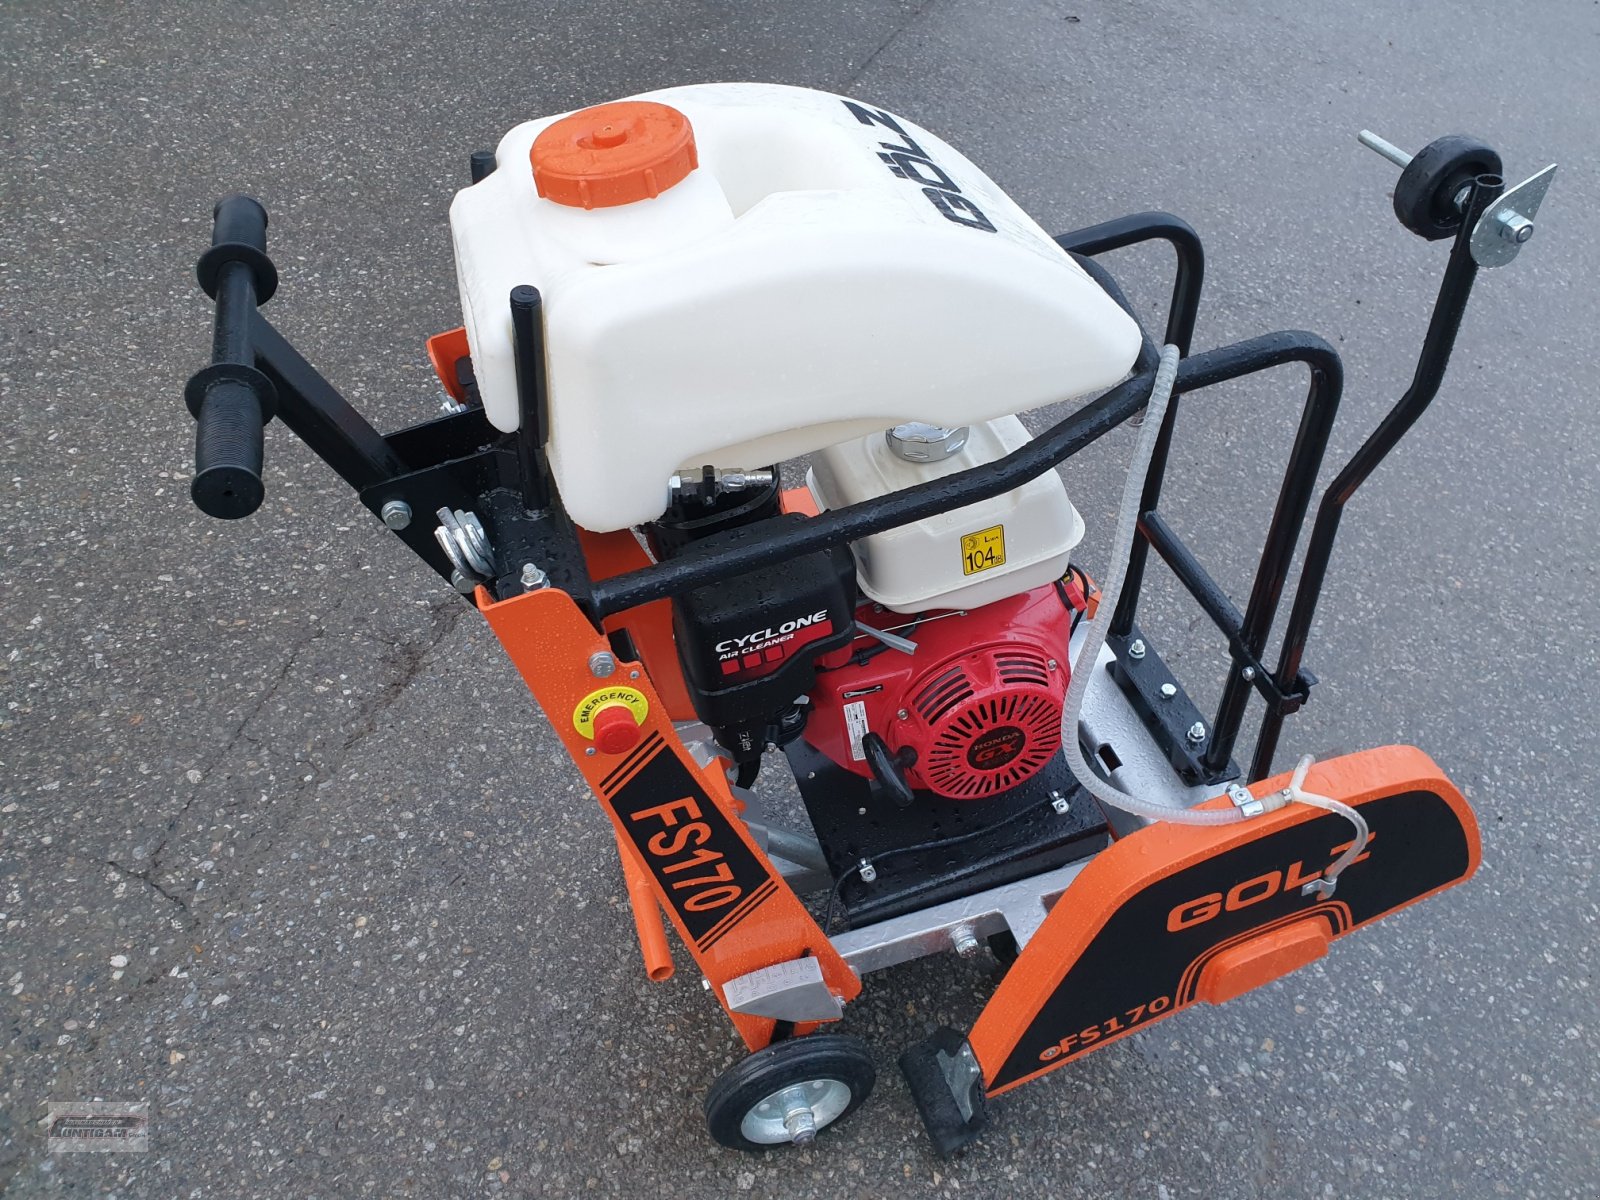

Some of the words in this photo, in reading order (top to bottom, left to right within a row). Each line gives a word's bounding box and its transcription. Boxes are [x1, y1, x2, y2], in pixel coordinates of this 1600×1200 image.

[840, 99, 998, 233] GÖLZ
[966, 546, 995, 571] 104
[715, 609, 828, 653] CYCLONE
[719, 651, 739, 661] AIR
[741, 633, 795, 655] CLEANER
[580, 692, 640, 723] EMERGENCY
[974, 732, 1020, 750] HONDA
[630, 796, 742, 912] FS170
[1060, 996, 1170, 1054] FS170
